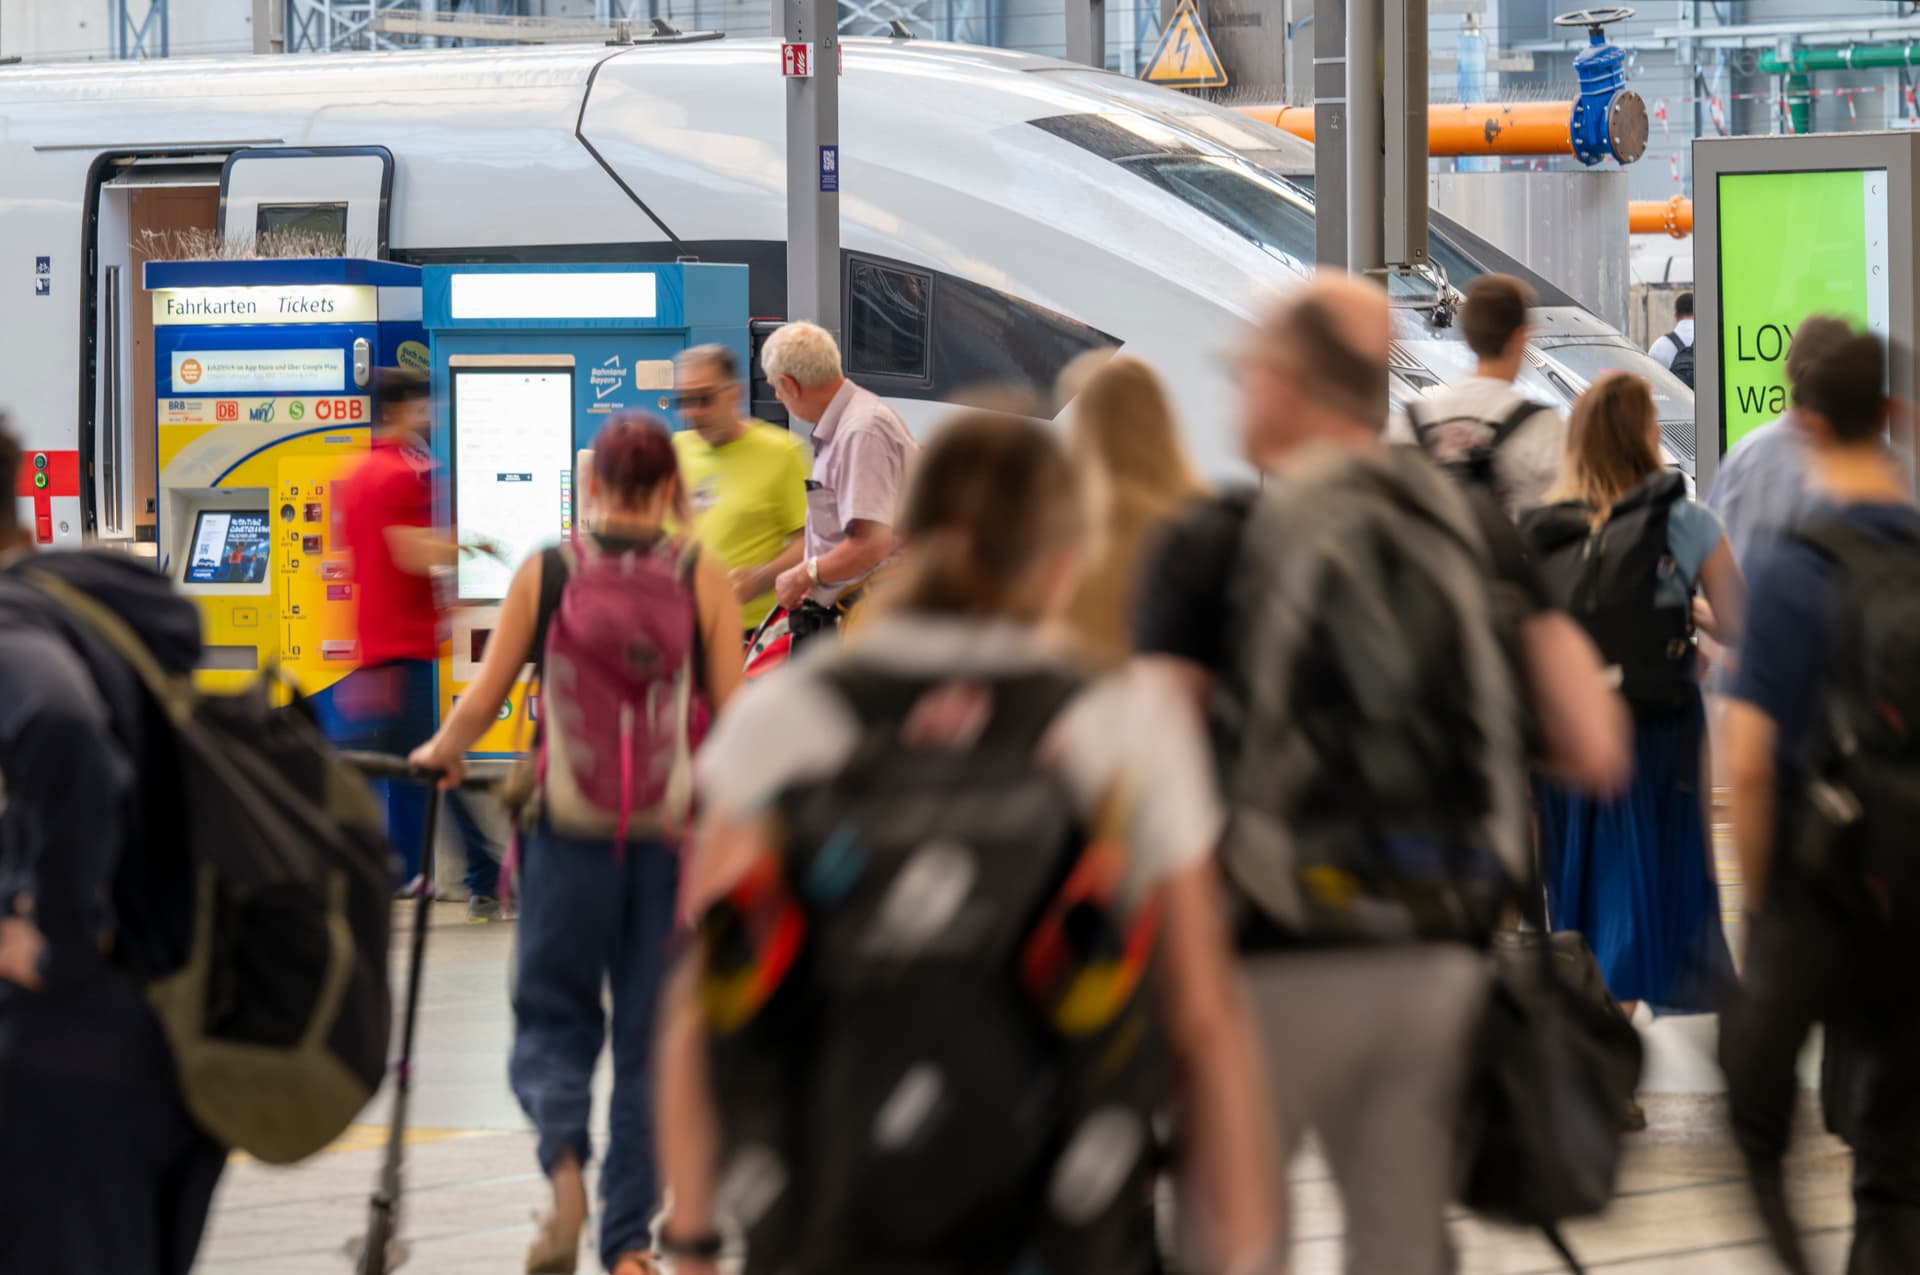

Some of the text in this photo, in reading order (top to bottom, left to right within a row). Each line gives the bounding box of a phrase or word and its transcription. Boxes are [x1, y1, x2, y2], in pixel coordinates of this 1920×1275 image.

[167, 295, 334, 315] Fahrkarten Tickets
[168, 400, 185, 410] BRB
[315, 400, 362, 420] ÖBB
